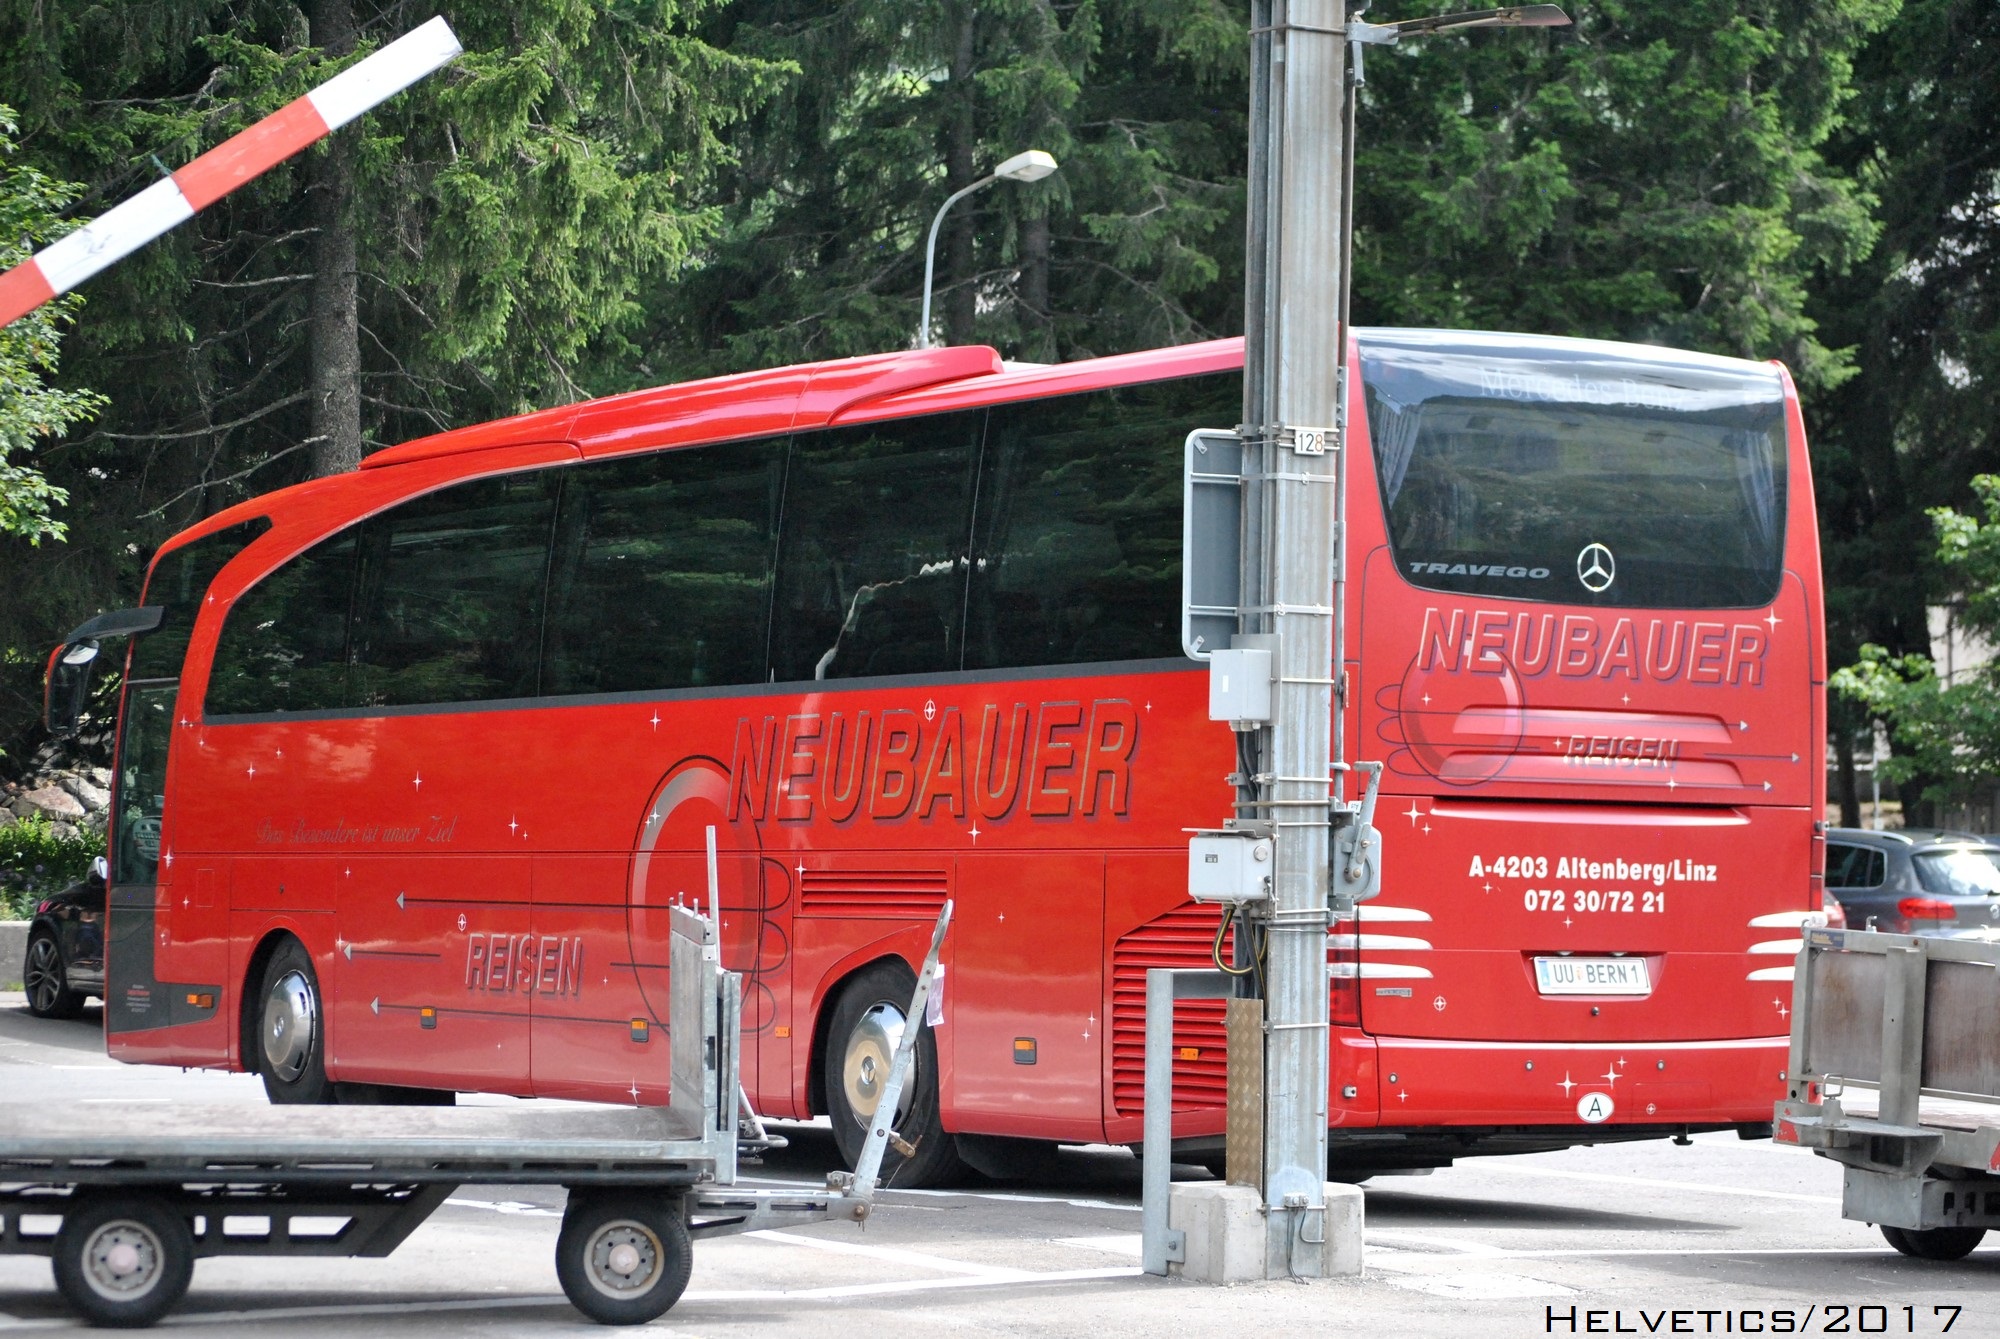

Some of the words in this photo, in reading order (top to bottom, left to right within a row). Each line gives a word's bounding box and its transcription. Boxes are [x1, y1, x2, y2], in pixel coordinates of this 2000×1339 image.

[1299, 432, 1323, 452] 128
[1409, 562, 1550, 579] TRAVEGO
[1416, 607, 1769, 686] NEUBAUER
[726, 698, 1139, 824] NEUBAUER
[1562, 735, 1678, 768] REISEN
[361, 823, 380, 843] ist
[382, 825, 421, 843] unser
[426, 815, 459, 843] Ziel
[1468, 855, 1549, 879] A-4203
[1556, 856, 1718, 886] Altenberg/Linz
[1524, 889, 1566, 912] 072
[1573, 891, 1634, 913] 30/72
[1641, 891, 1665, 913] 21
[465, 933, 584, 997] REISEN
[1553, 963, 1575, 984] UU
[1587, 1096, 1603, 1118] A
